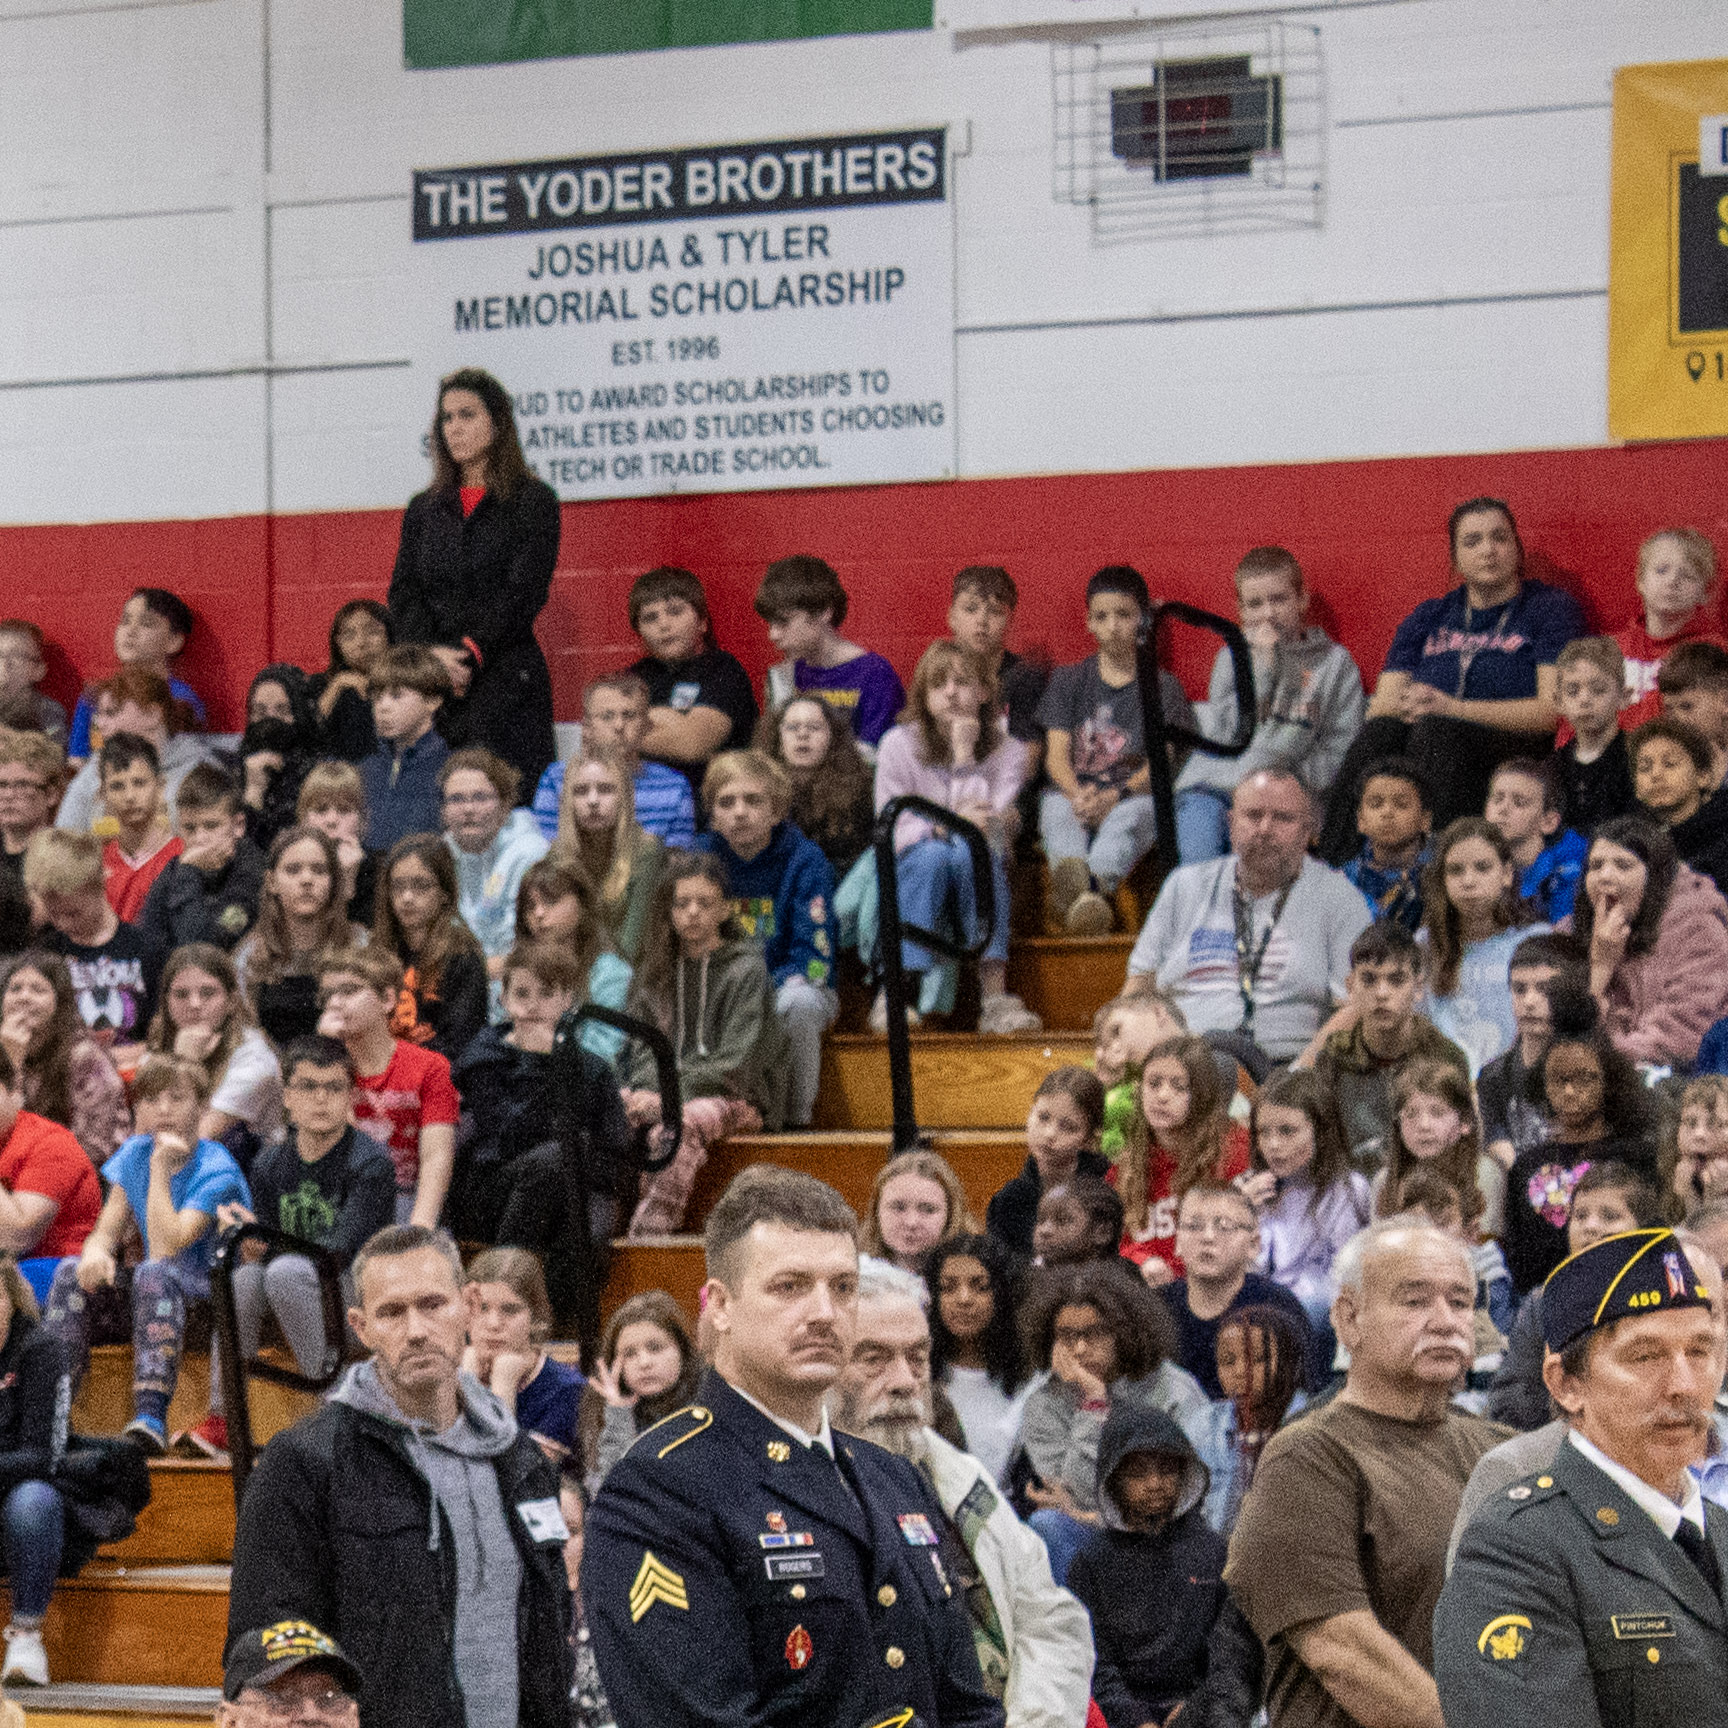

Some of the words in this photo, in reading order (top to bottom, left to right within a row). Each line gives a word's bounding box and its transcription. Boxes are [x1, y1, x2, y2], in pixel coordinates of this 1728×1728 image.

[422, 178, 507, 227] THE
[518, 161, 673, 219] YODER
[684, 142, 938, 205] BROTHERS
[528, 231, 670, 281] JOSHUA
[679, 233, 704, 267] &
[716, 224, 831, 265] TYLER
[454, 285, 639, 333] MEMORIAL
[649, 266, 907, 319] SCHOLARSHIP
[611, 340, 656, 368] EST.
[666, 334, 721, 362] 1996
[555, 387, 585, 415] TO
[590, 381, 670, 413] AWARD
[675, 369, 852, 406] SCHOLARSHIPS
[860, 368, 890, 396] TO
[525, 419, 639, 450] ATHLETES
[645, 415, 687, 443] AND
[695, 407, 815, 442] STUDENTS
[821, 400, 945, 434] CHOOSING
[549, 456, 606, 485] TECH
[612, 451, 643, 480] OR
[650, 447, 727, 477] TRADE
[732, 443, 832, 475] SCHOOL.
[1628, 1289, 1662, 1308] 459
